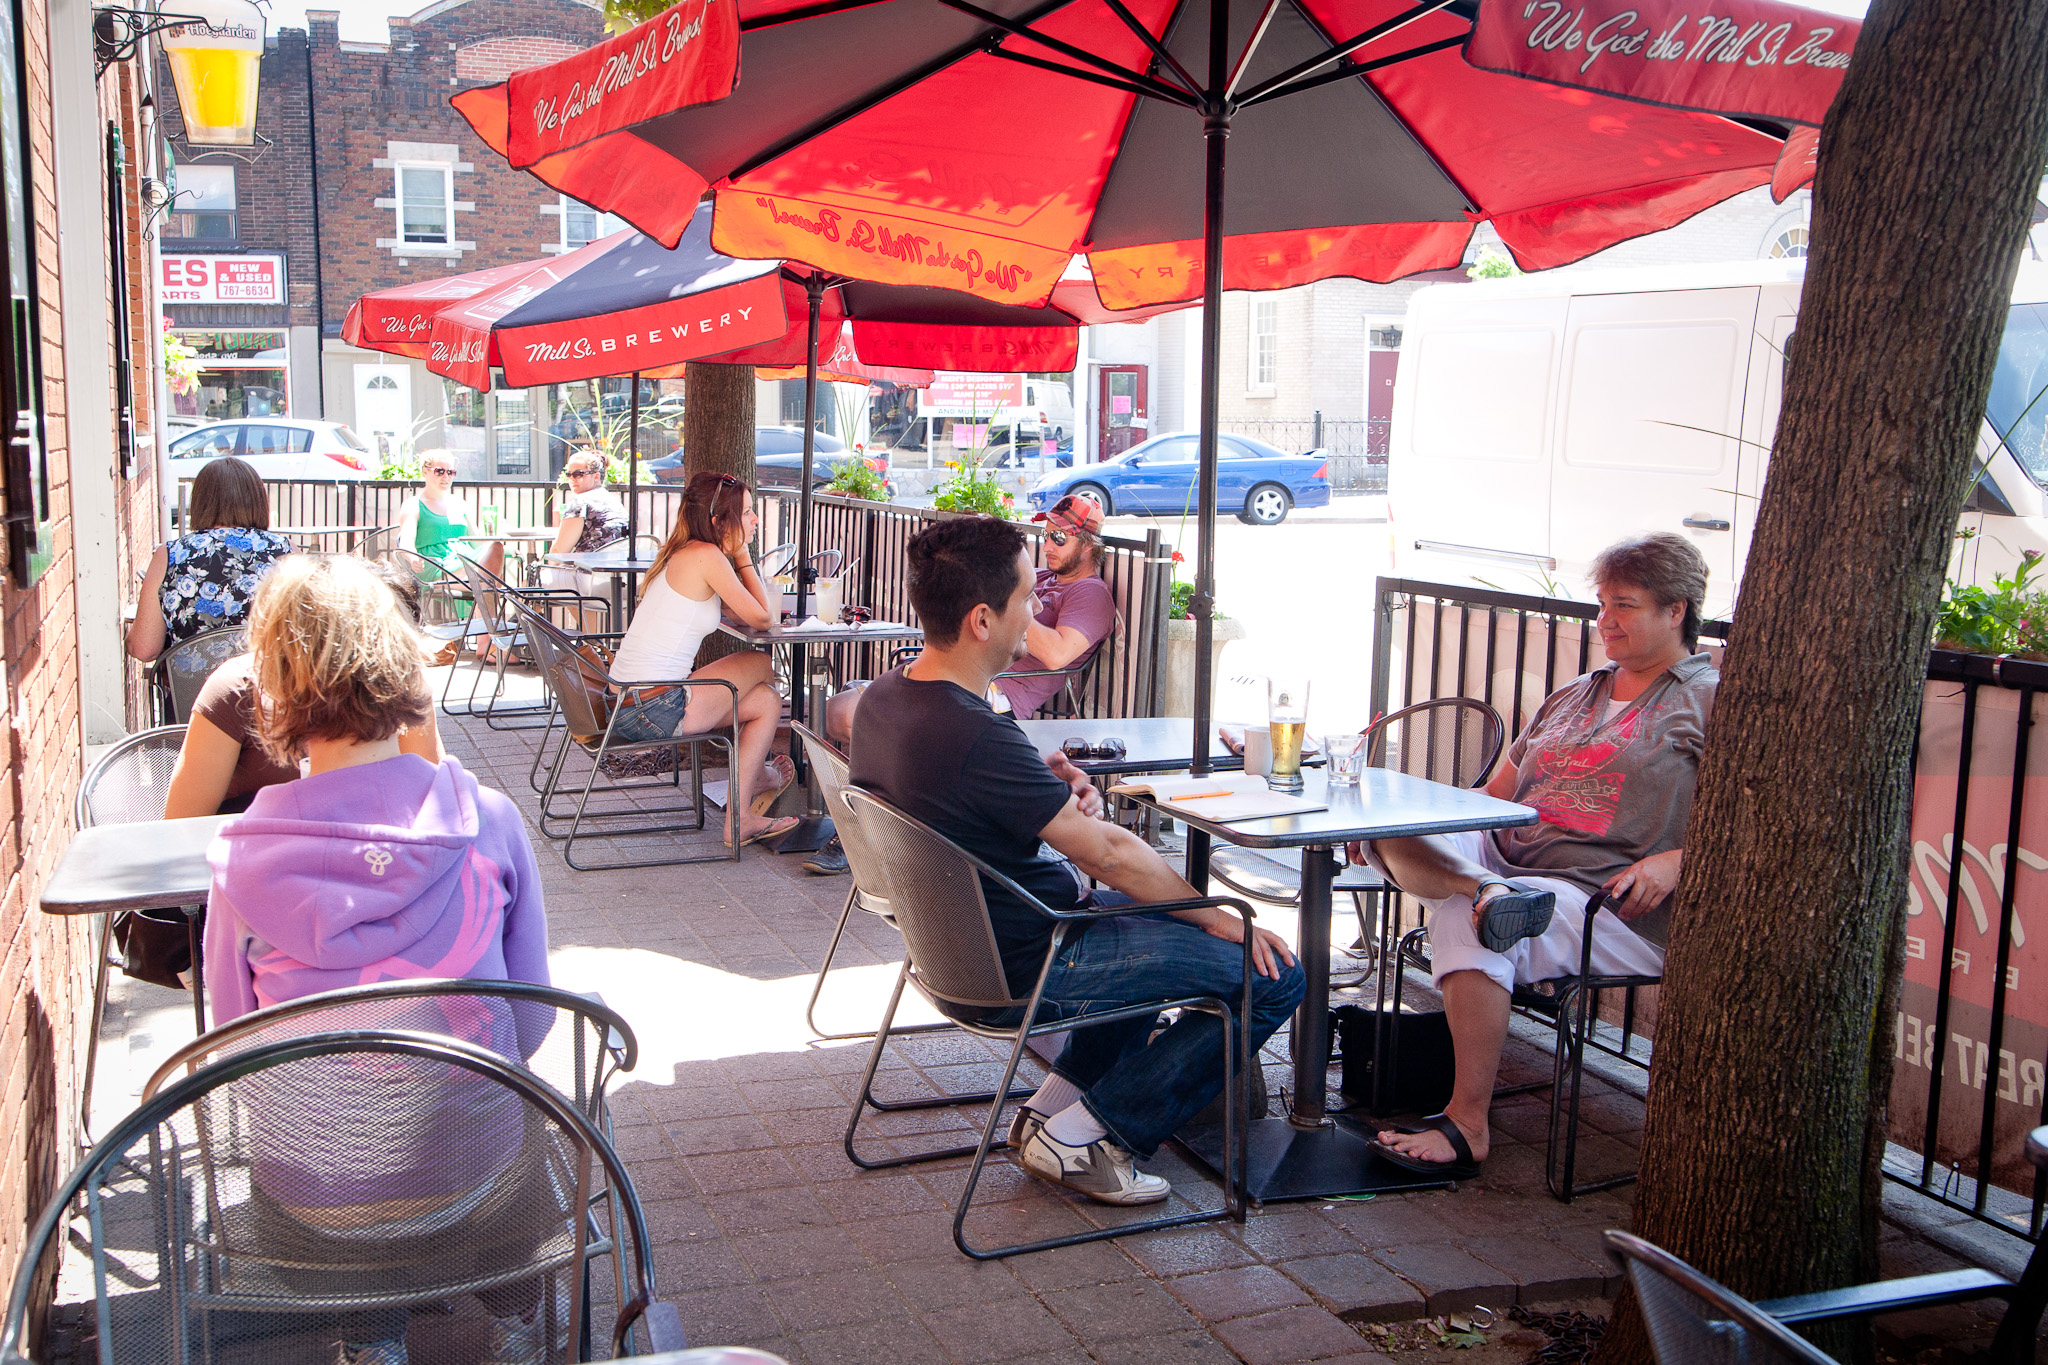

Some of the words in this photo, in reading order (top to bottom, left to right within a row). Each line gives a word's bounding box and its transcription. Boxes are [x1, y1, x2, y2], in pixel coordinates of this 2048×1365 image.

[188, 23, 256, 39] Hoegaarden
[1522, 1, 1584, 51] "We
[1580, 9, 1650, 74] Got
[1645, 13, 1687, 61] the
[1685, 14, 1768, 63] Mill
[1745, 22, 1793, 66] St.
[533, 95, 559, 138] "We
[559, 80, 586, 142] Got
[601, 38, 645, 94] Mill
[229, 263, 260, 273] NEW
[219, 273, 230, 282] &
[235, 273, 272, 282] USED
[223, 285, 269, 296] 767-6634
[381, 316, 407, 334] "We
[407, 313, 427, 339] Got
[524, 341, 572, 363] Mill
[572, 337, 597, 359] St.
[601, 306, 753, 352] BREWERY
[966, 375, 1005, 383] DESIGNER
